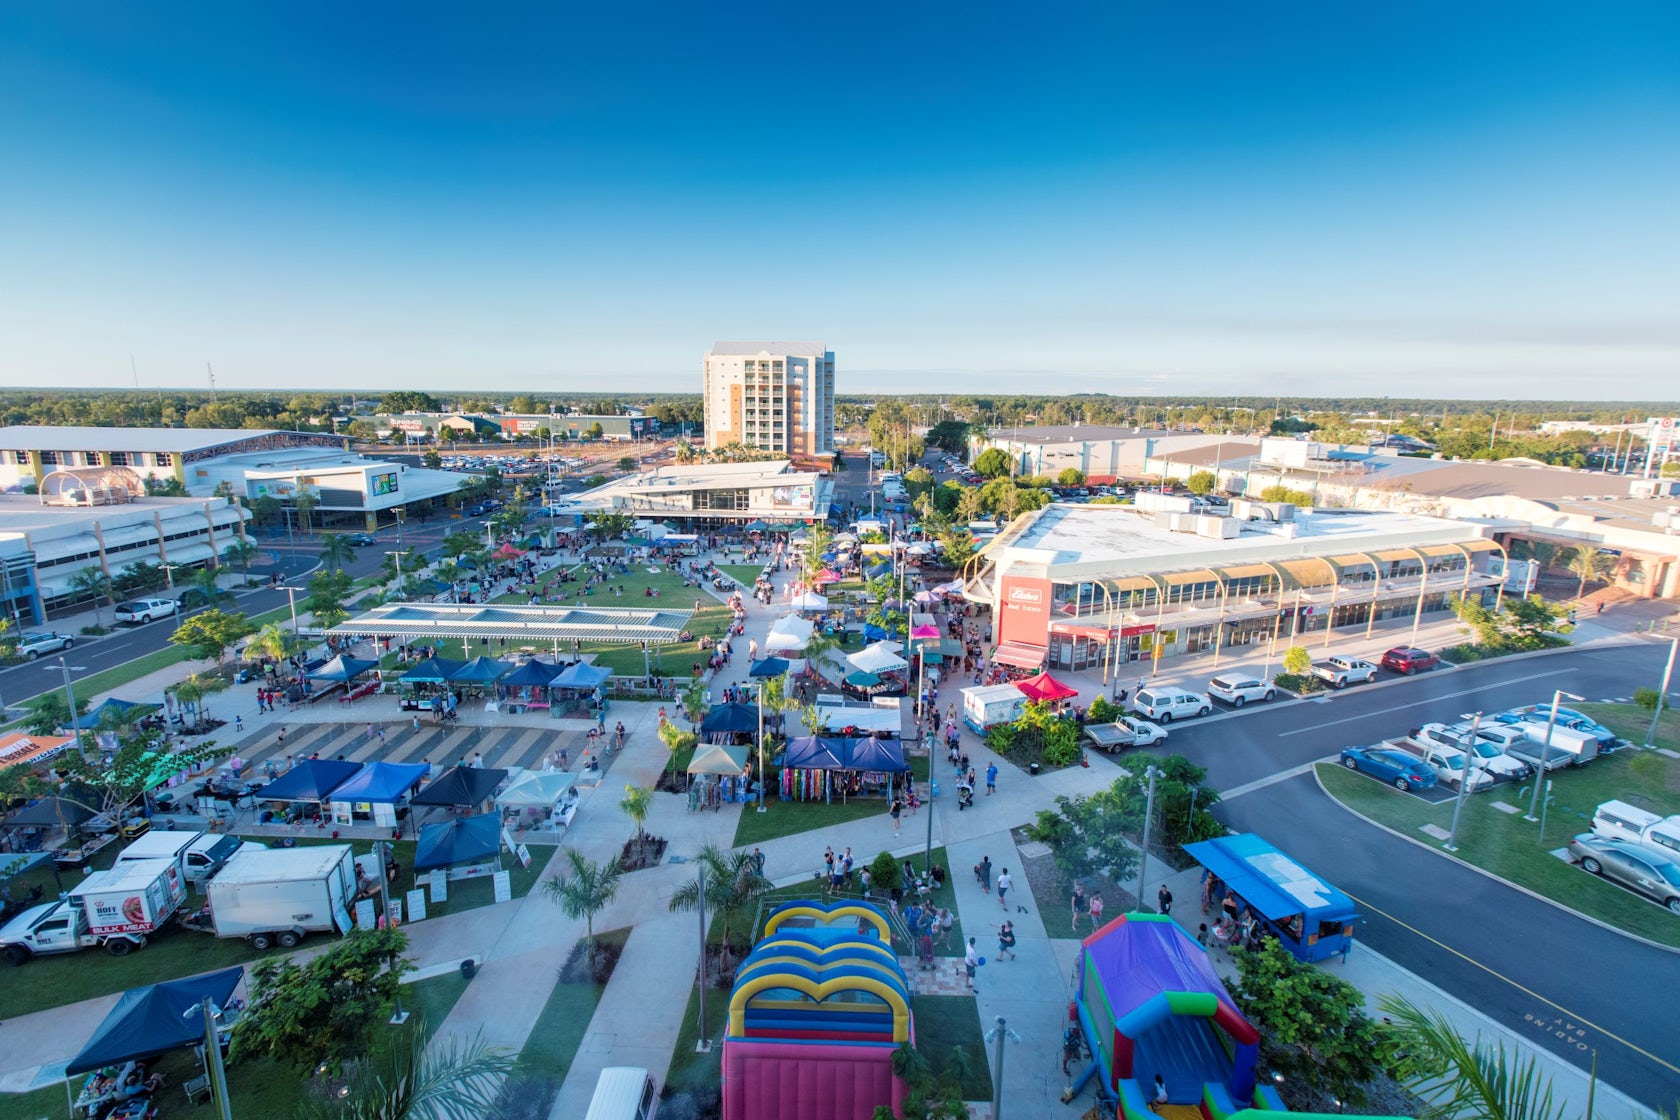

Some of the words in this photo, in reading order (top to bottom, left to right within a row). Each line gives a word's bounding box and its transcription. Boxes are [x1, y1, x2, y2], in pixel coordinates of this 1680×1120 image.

[92, 924, 120, 934] BULK
[123, 922, 151, 932] MEAT
[1554, 1019, 1586, 1037] BAY
